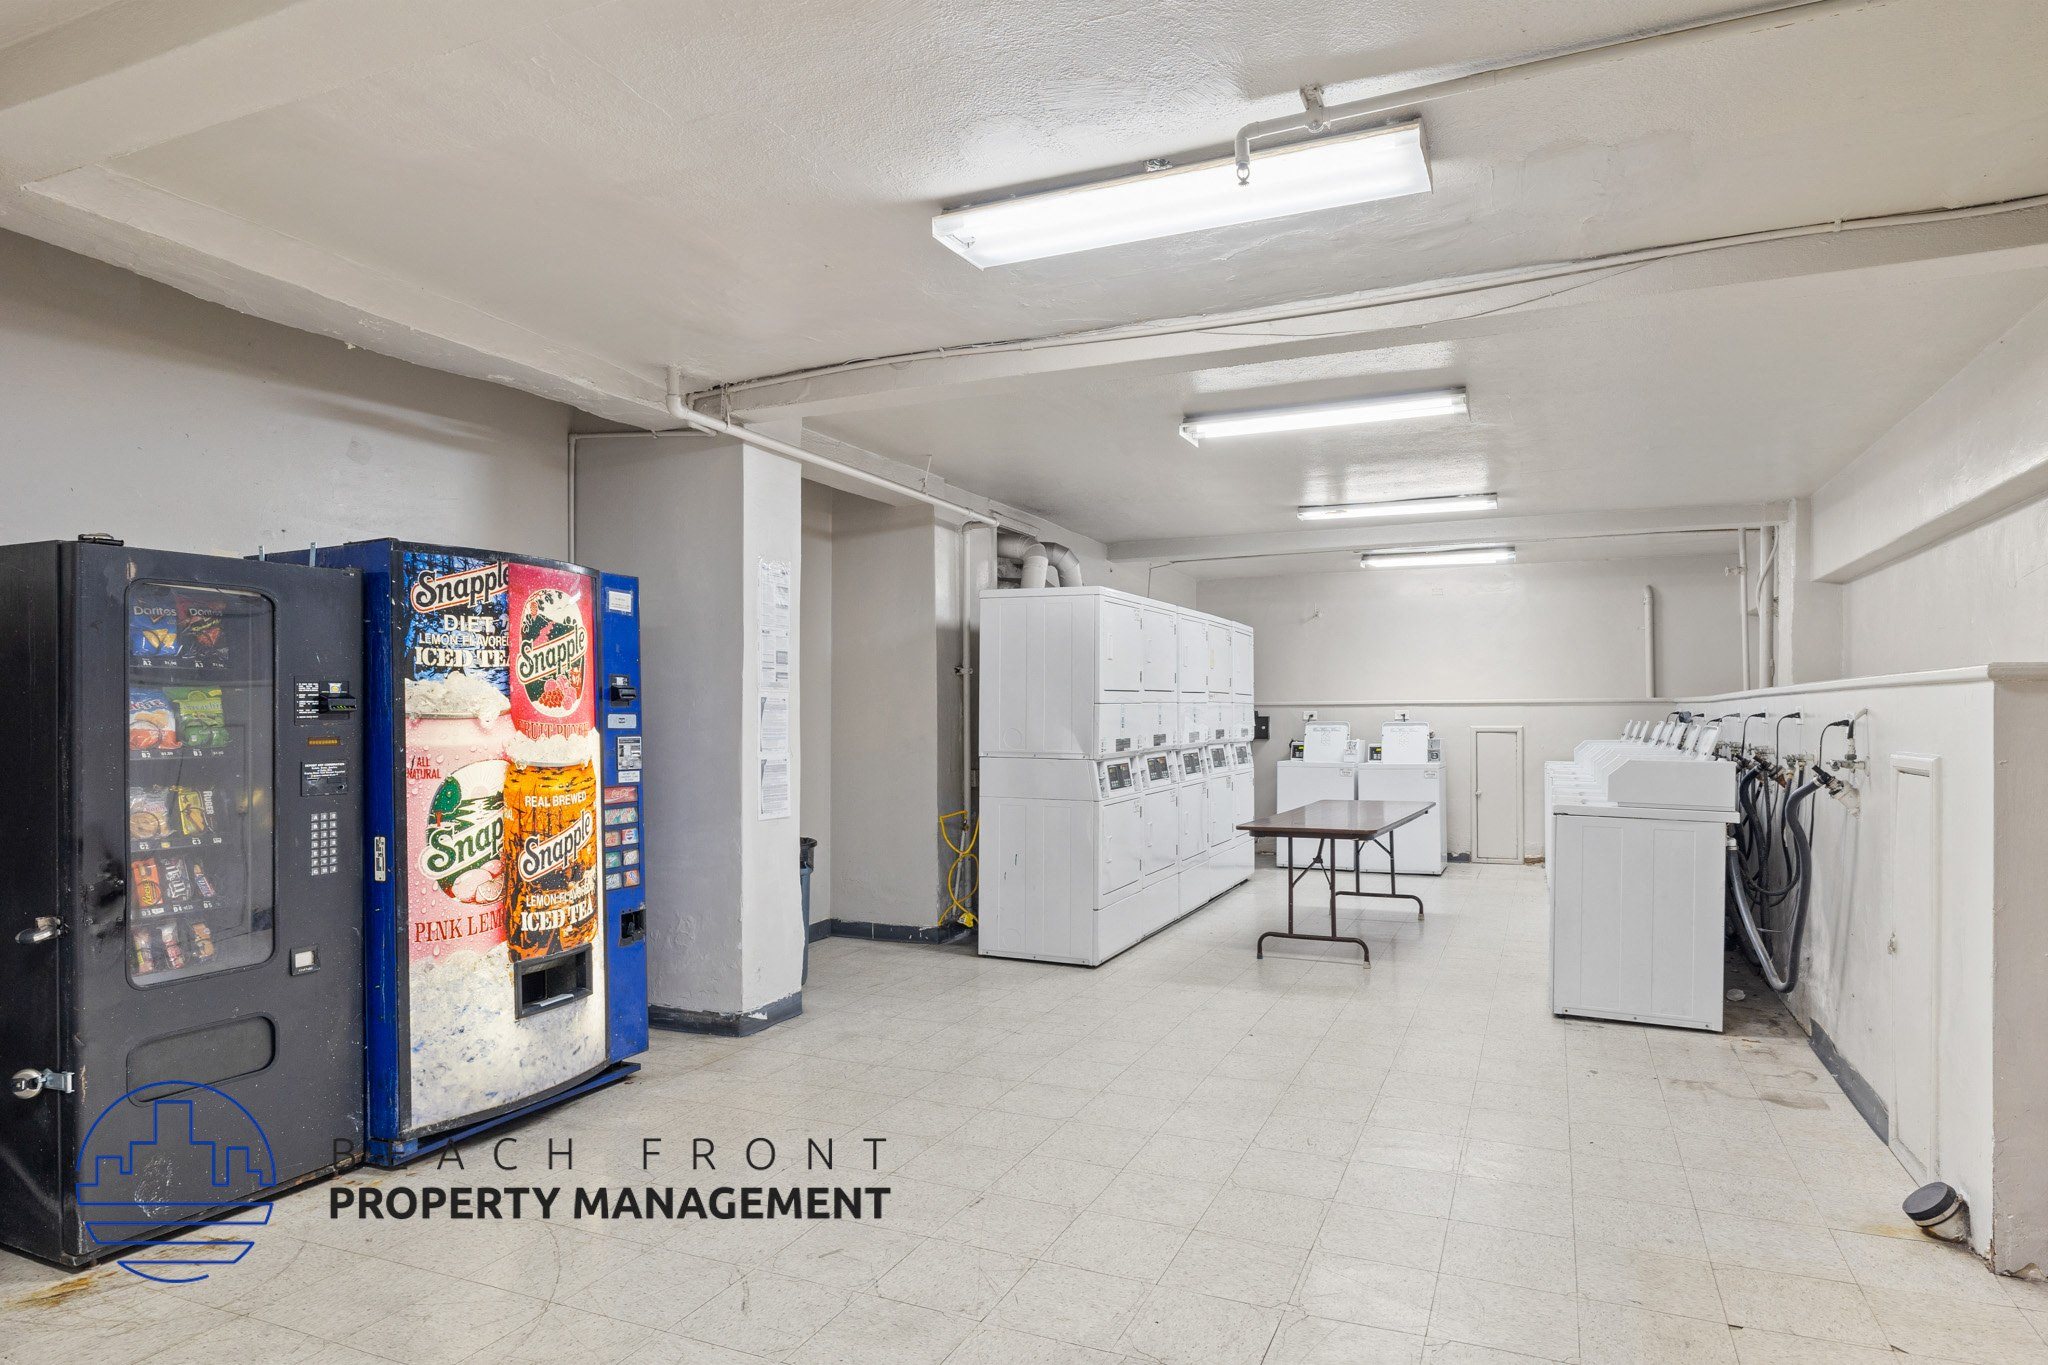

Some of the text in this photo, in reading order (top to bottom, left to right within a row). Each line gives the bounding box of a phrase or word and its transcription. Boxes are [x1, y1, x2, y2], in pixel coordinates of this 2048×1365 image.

[416, 560, 508, 607] Snapple
[134, 606, 176, 616] Doritos
[444, 614, 494, 633] DIET
[418, 632, 458, 645] LEMON
[414, 646, 473, 667] ICED
[519, 626, 585, 678] Snapple
[416, 756, 431, 767] ALL
[406, 768, 441, 780] NATURAL
[524, 790, 586, 808] REAL BREWED
[522, 810, 592, 876] Snapple
[526, 894, 557, 908] LEMON
[520, 897, 594, 932] ICED TEA
[414, 919, 462, 942] PINK
